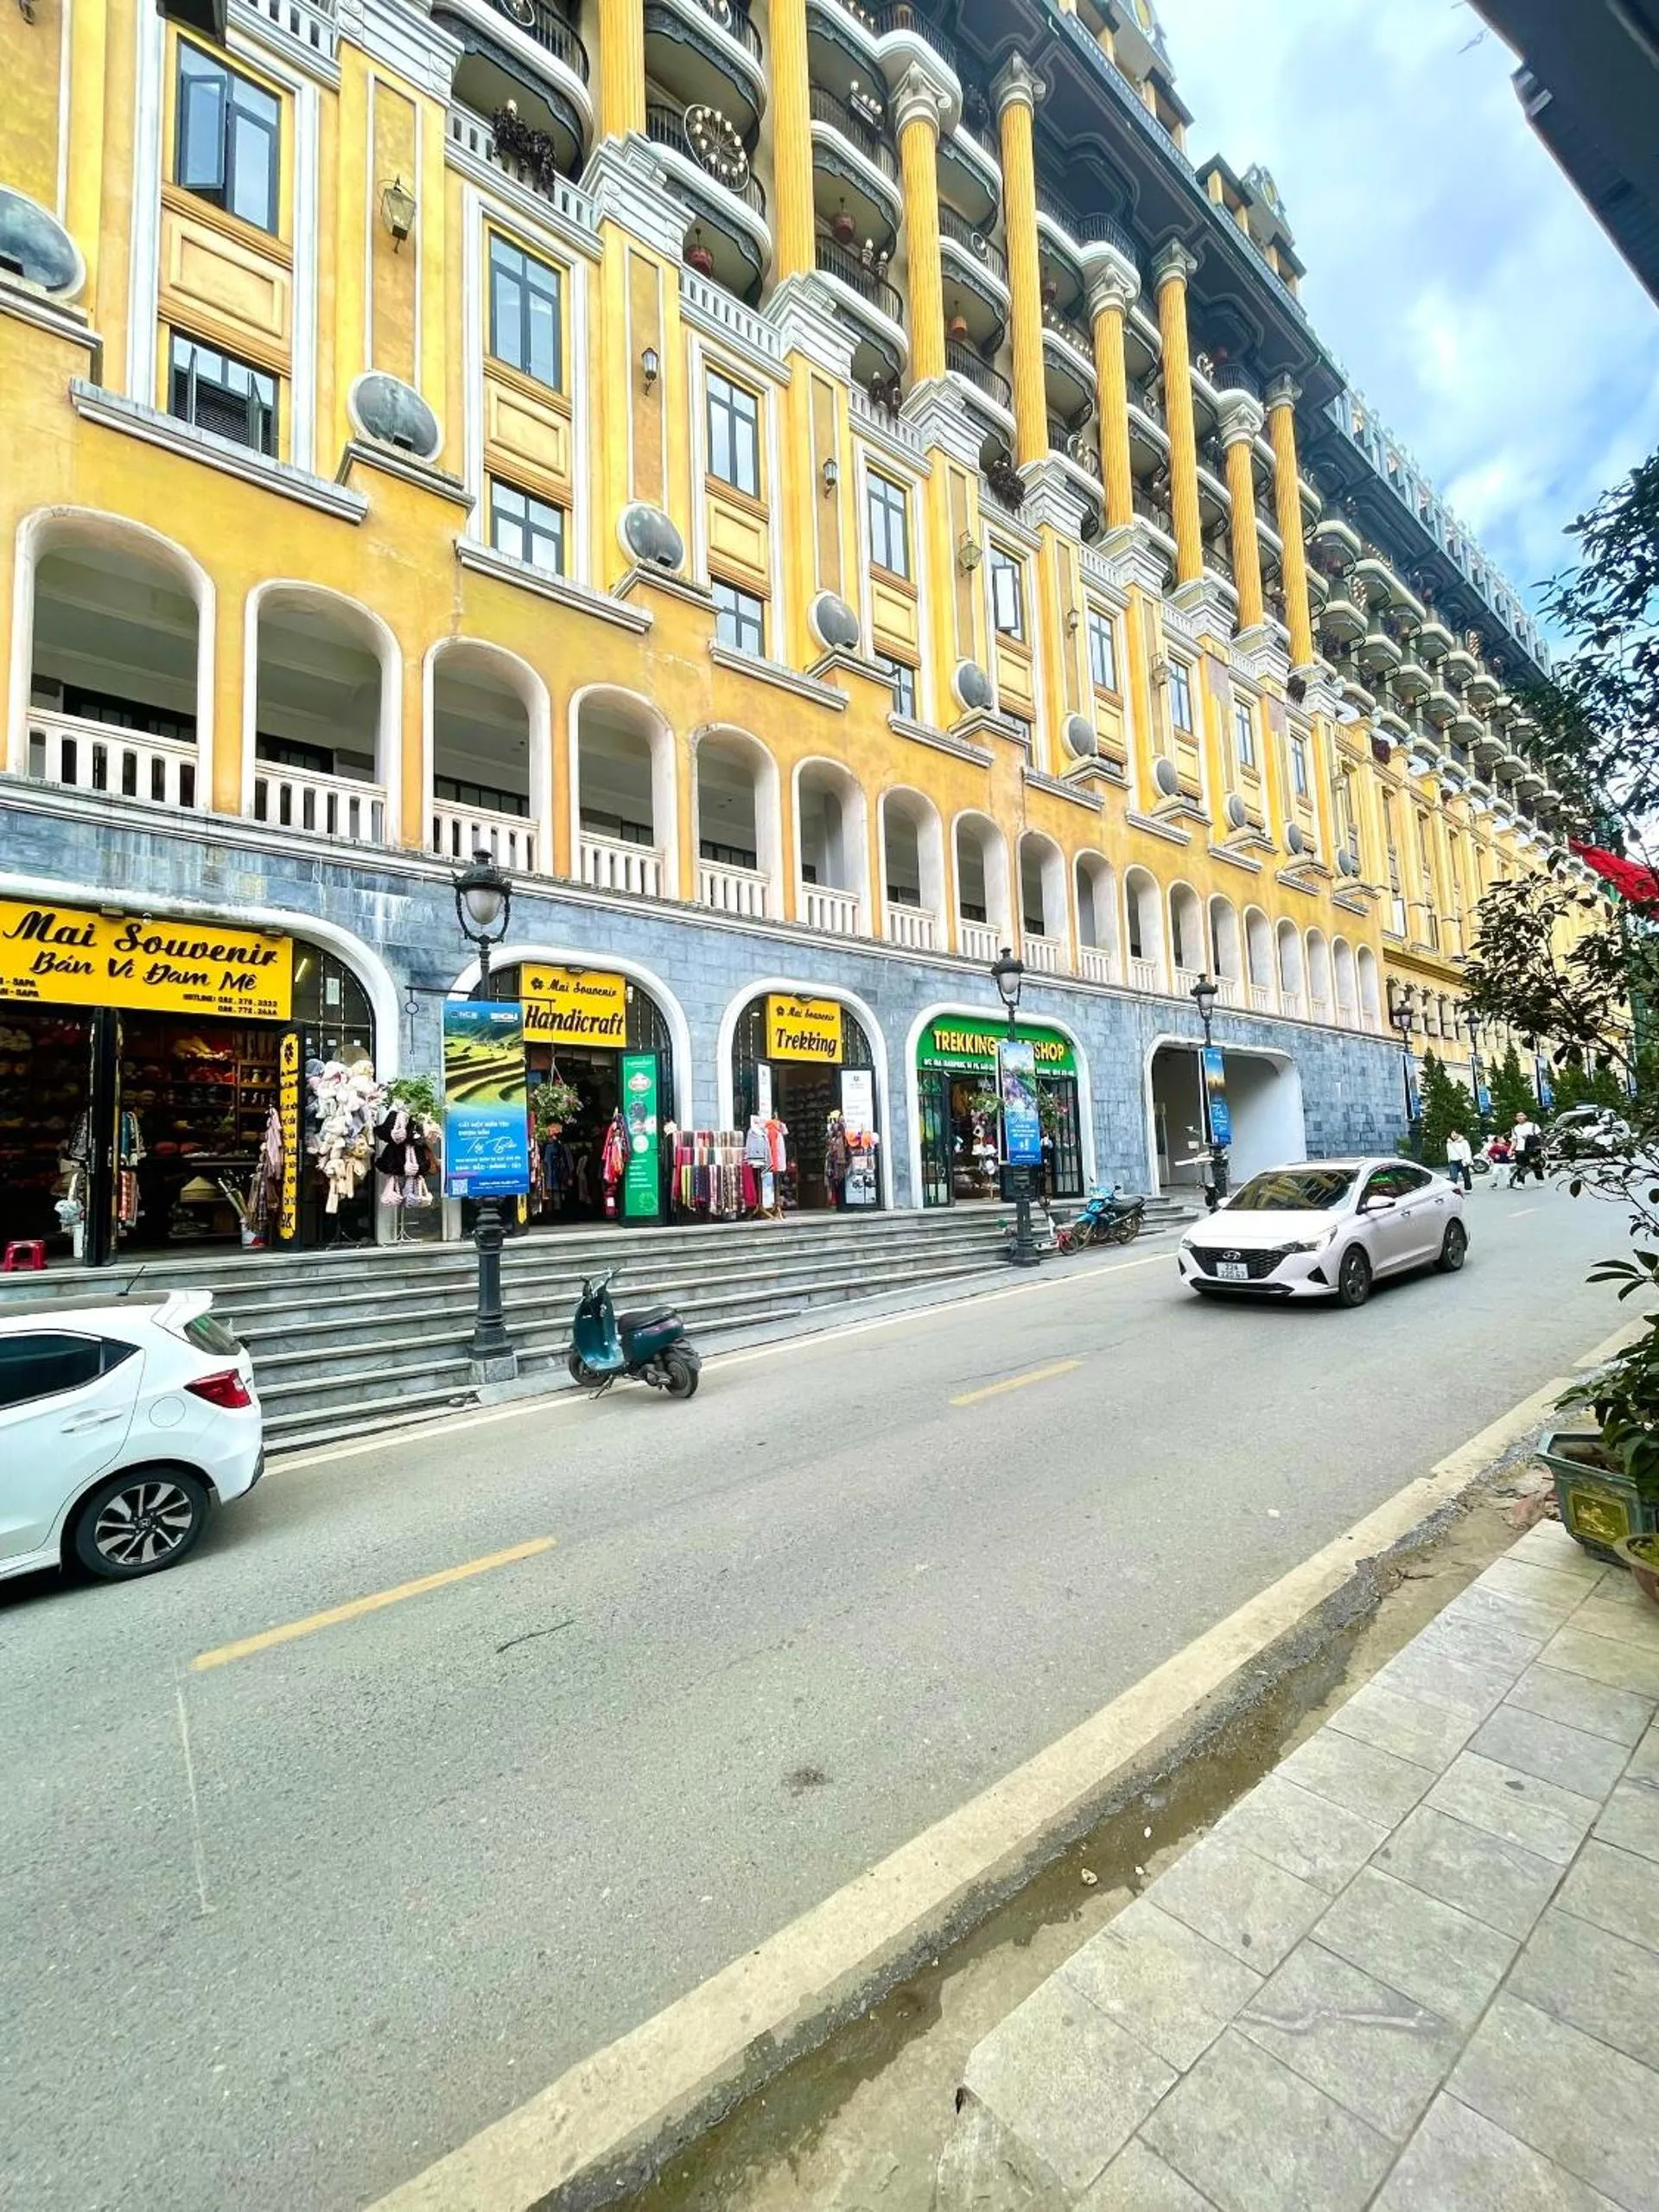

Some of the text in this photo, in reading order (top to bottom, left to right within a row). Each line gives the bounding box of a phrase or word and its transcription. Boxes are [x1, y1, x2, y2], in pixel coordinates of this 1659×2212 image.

[3, 911, 278, 966] Mai Souvenir
[29, 950, 95, 976] Bán
[143, 963, 211, 987] Đam
[219, 971, 258, 993] Mê
[548, 978, 617, 997] Mai Souvenir
[524, 1004, 624, 1035] Handicraft
[776, 1027, 837, 1058] Trekking
[933, 1029, 1065, 1062] TREKKING SHOP
